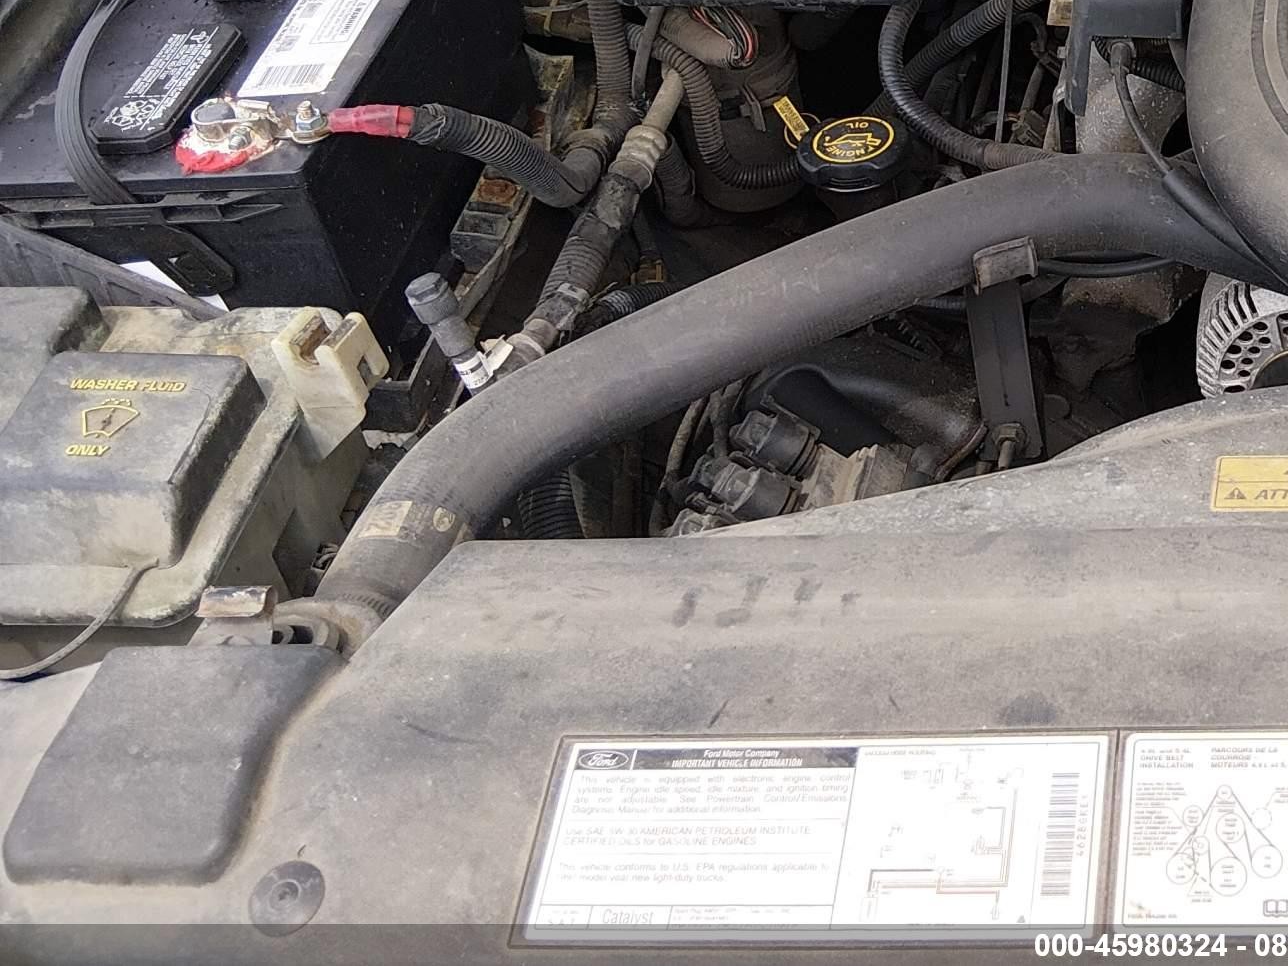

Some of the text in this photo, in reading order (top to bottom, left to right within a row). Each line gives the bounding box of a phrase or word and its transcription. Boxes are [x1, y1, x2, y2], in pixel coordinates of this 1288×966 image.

[69, 377, 186, 393] WASHER FLUID
[65, 443, 111, 457] ONLY
[745, 749, 779, 758] Company
[588, 753, 619, 766] Ford
[671, 759, 716, 768] IMPORTANT
[750, 758, 803, 767] INFORMATION
[658, 775, 700, 785] equipped
[783, 775, 811, 784] engine
[819, 774, 850, 782] control
[766, 785, 783, 793] and
[785, 785, 818, 794] ignition
[822, 784, 849, 794] timing
[707, 794, 754, 803] Powertrain
[586, 826, 604, 835] SAE
[640, 826, 692, 835] AMERICAN
[695, 826, 757, 835] PETROLEUM
[760, 825, 812, 834] INSTITUTE
[658, 836, 710, 845] GASOLINE
[614, 863, 656, 871] conforms
[660, 863, 669, 871] to
[695, 862, 715, 871] EPA
[718, 863, 768, 873] regulations
[602, 908, 655, 927] Catalyst
